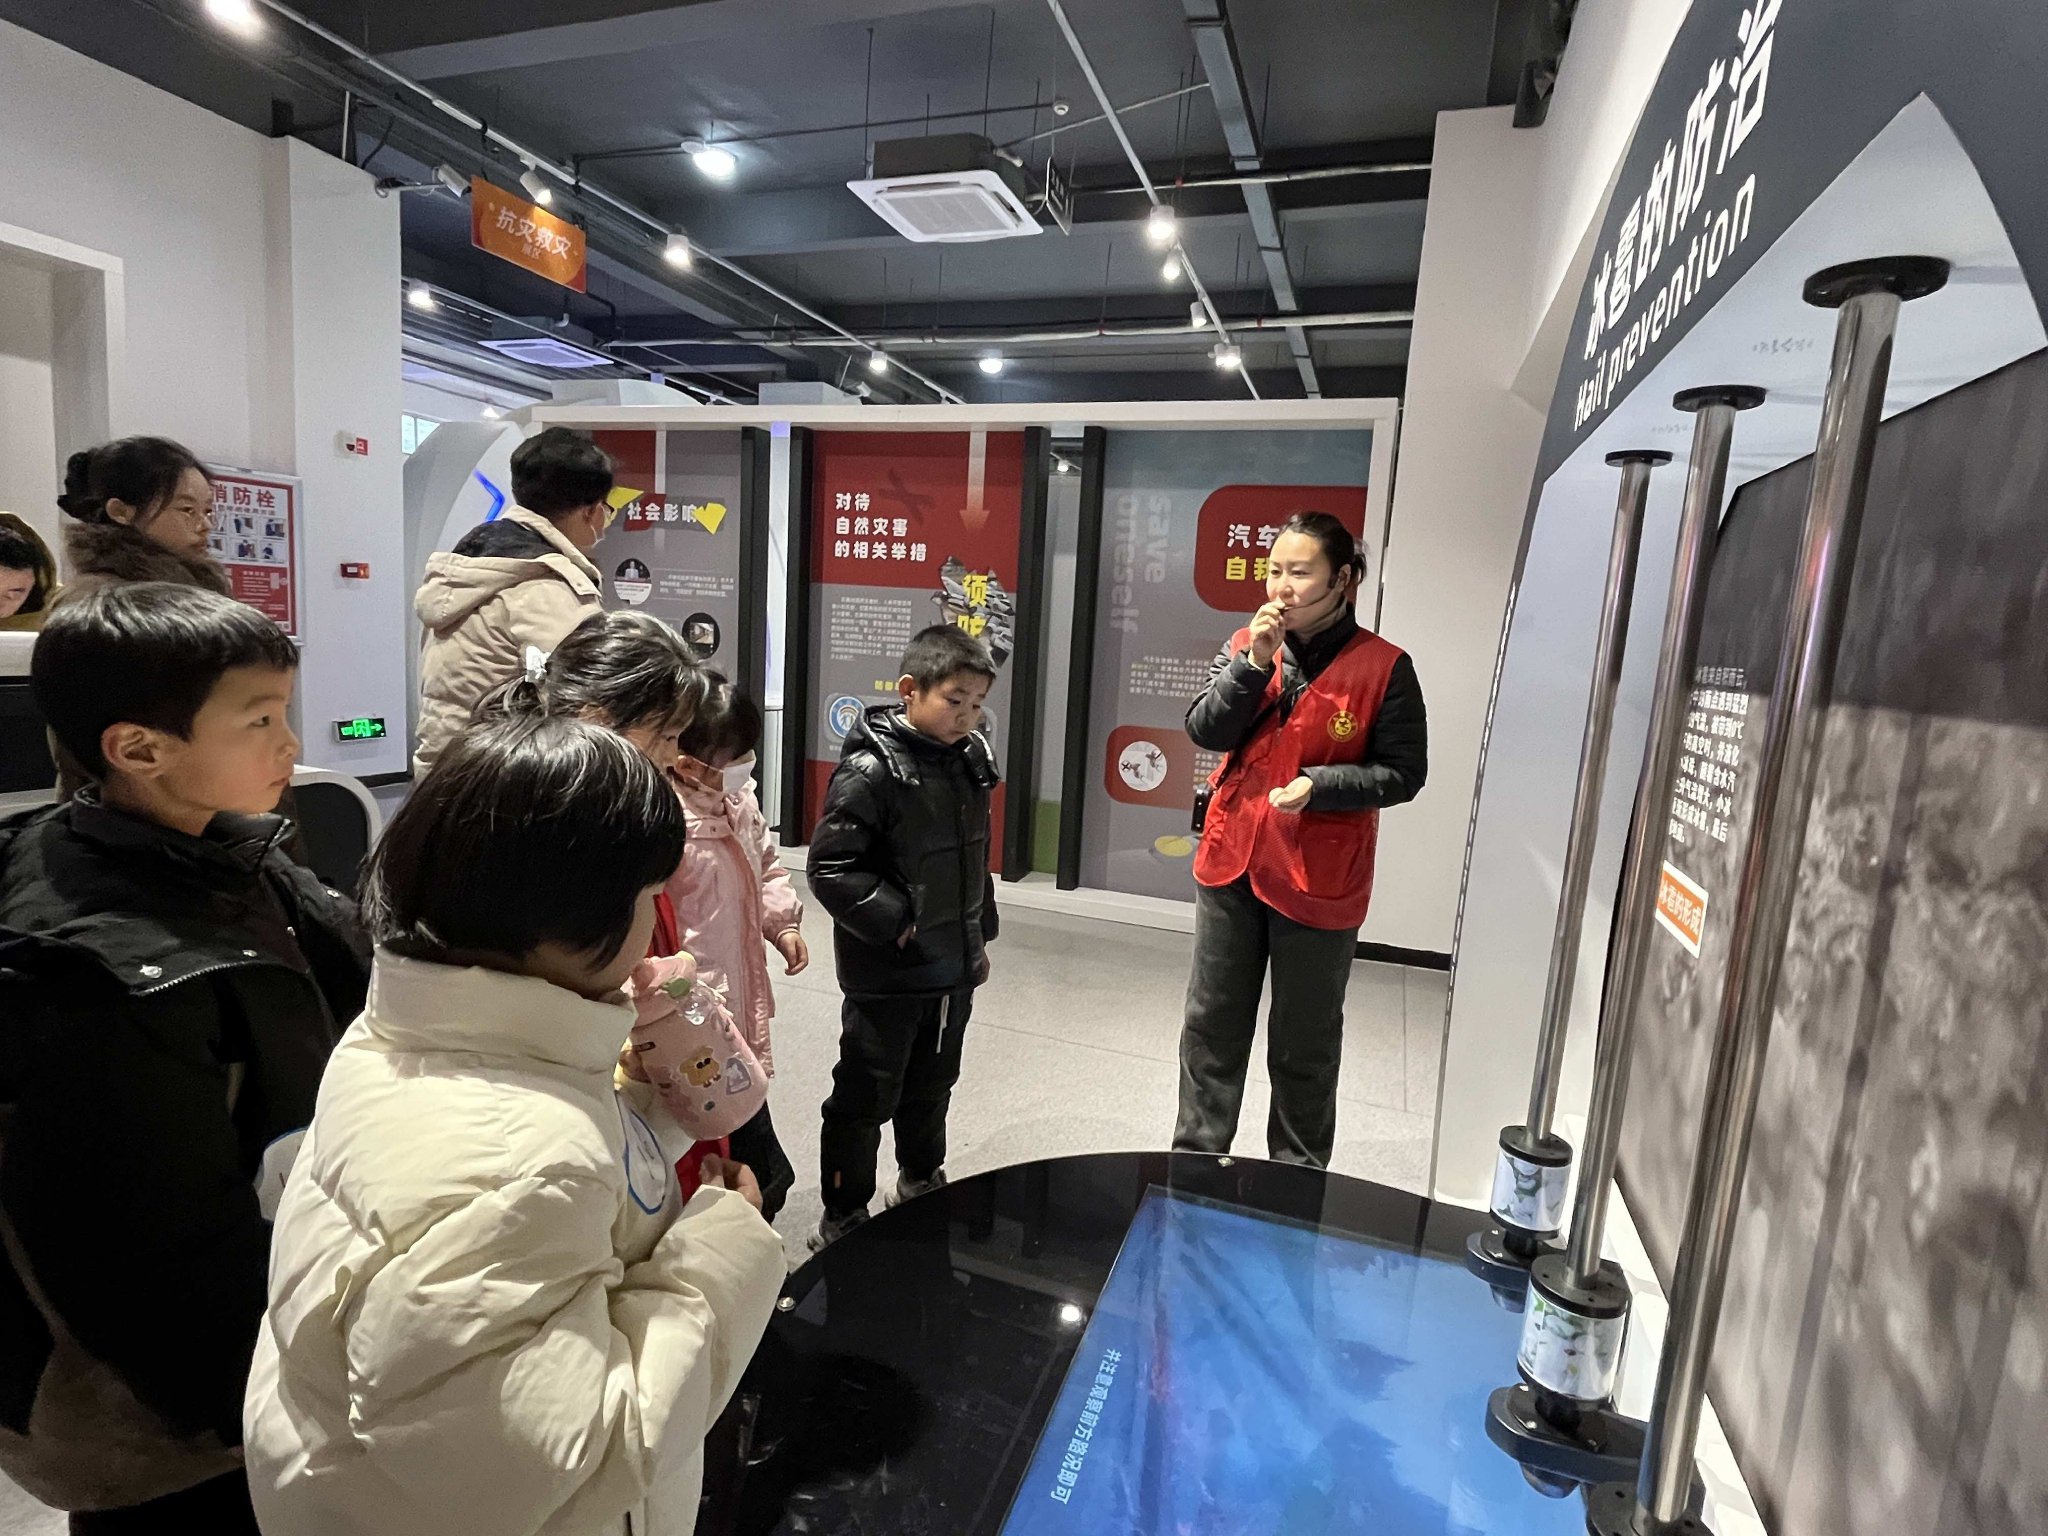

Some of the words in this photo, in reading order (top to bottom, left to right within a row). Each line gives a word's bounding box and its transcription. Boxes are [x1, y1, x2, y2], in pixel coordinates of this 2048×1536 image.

[496, 206, 571, 259] 抗灾救灾
[1574, 350, 1607, 431] Hail
[1604, 174, 1756, 410] prevention
[627, 502, 697, 523] 社会影响
[835, 492, 870, 512] 对待
[835, 516, 908, 537] 自然灾害
[1144, 495, 1172, 583] save
[1227, 523, 1280, 549] 汽车
[834, 539, 927, 562] 的相关举措
[1109, 493, 1140, 633] oneself
[1050, 1348, 1122, 1505] 并注意观察前方路况即可
